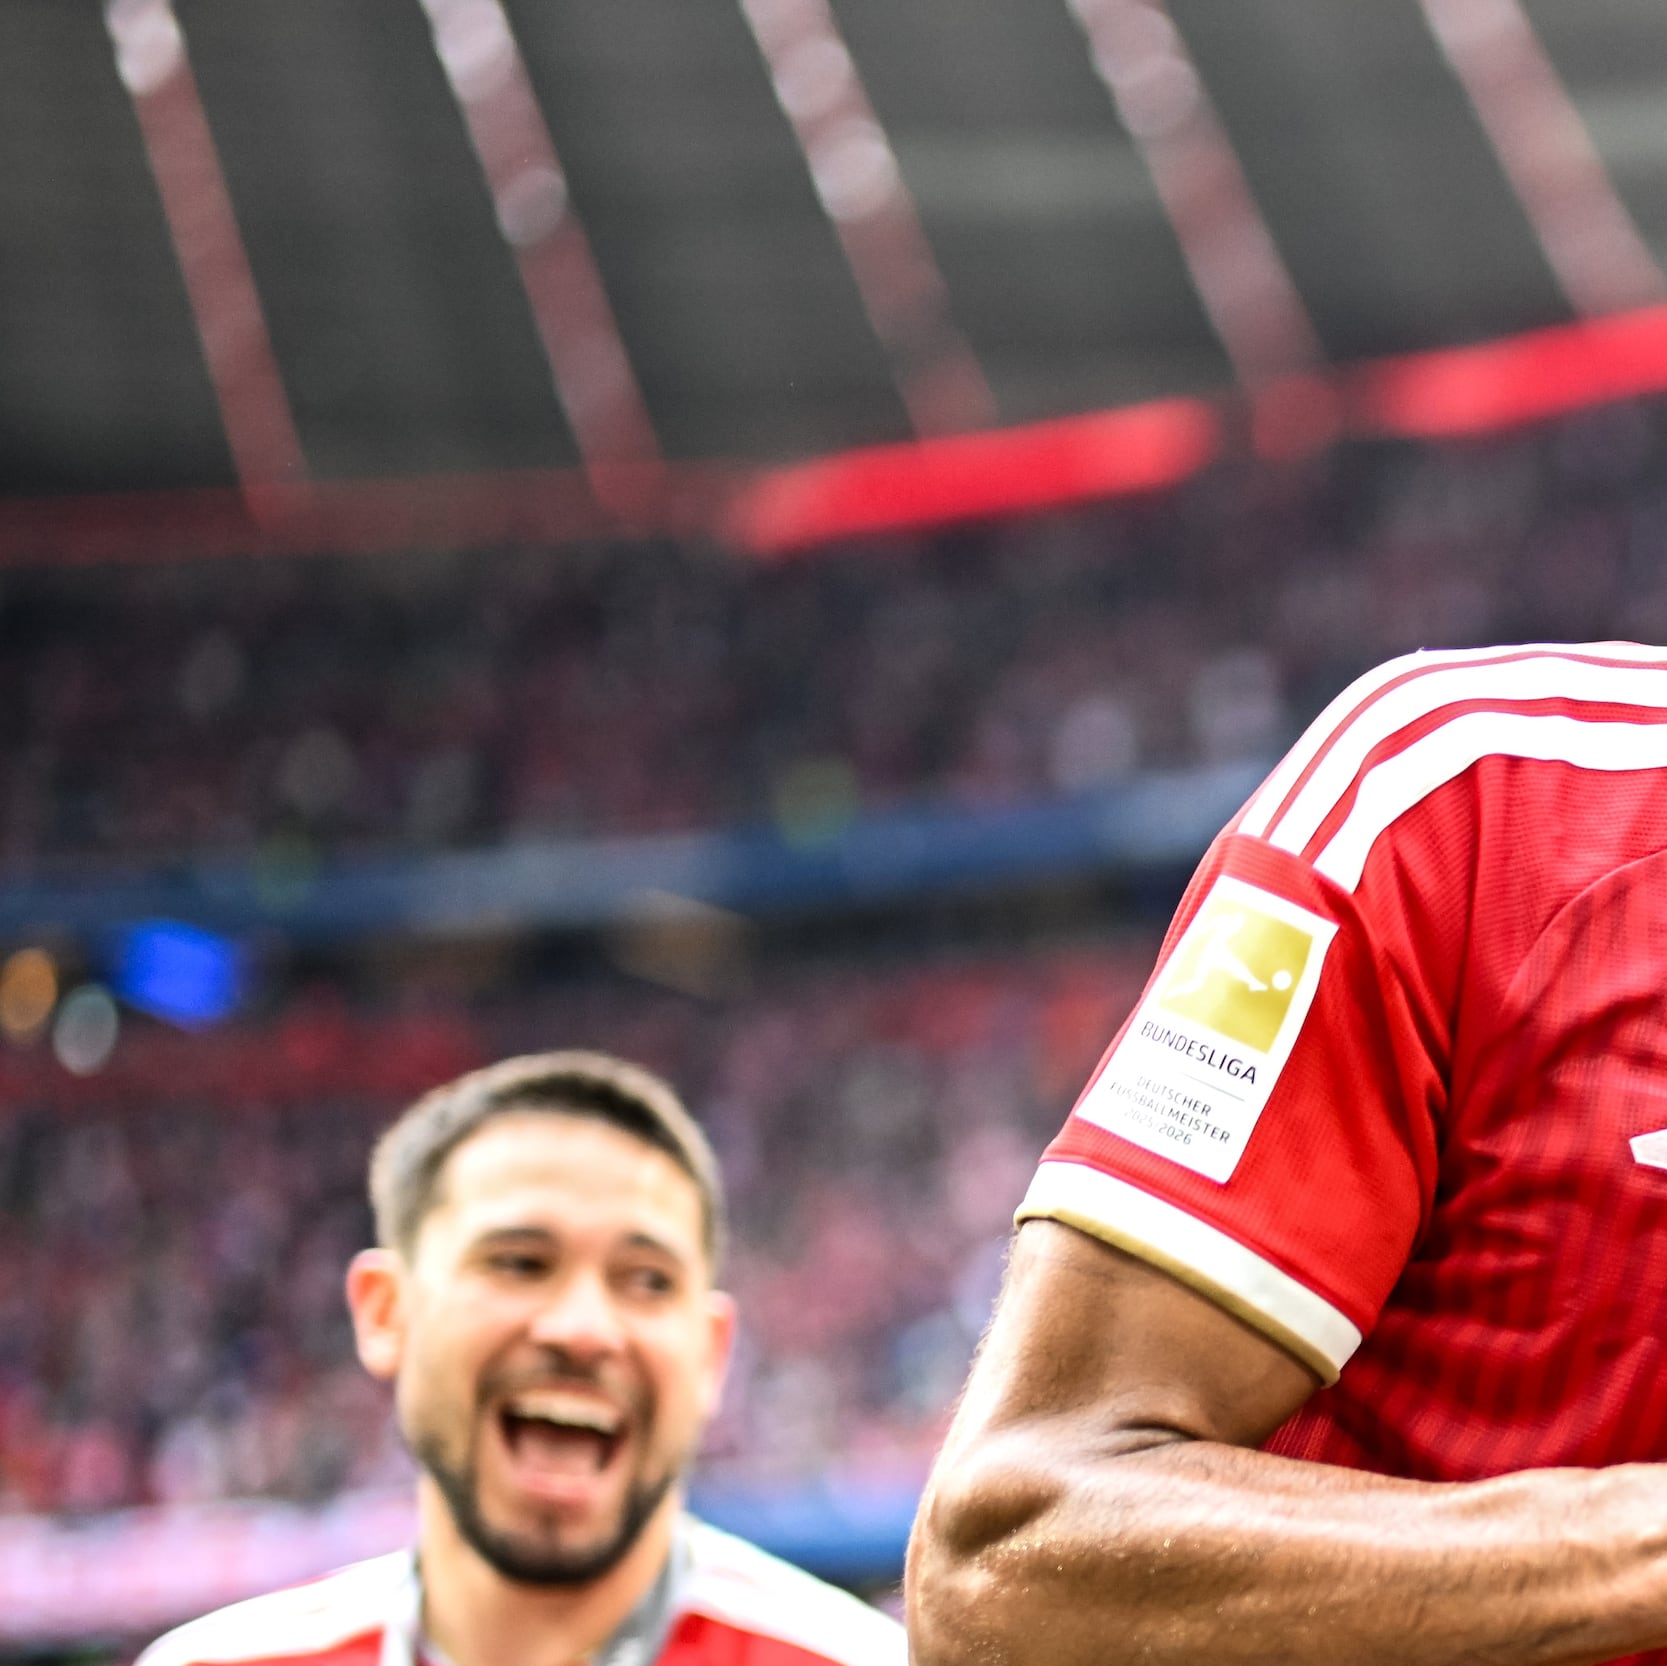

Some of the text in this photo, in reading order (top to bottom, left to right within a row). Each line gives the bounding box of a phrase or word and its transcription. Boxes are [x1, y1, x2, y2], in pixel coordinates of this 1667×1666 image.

[1140, 1021, 1257, 1085] BUNDESLIGA
[1109, 1082, 1231, 1144] FUSSBALLMEISTER
[1136, 1076, 1212, 1117] DEUTSCHER
[1124, 1108, 1192, 1146] 2025/2026
